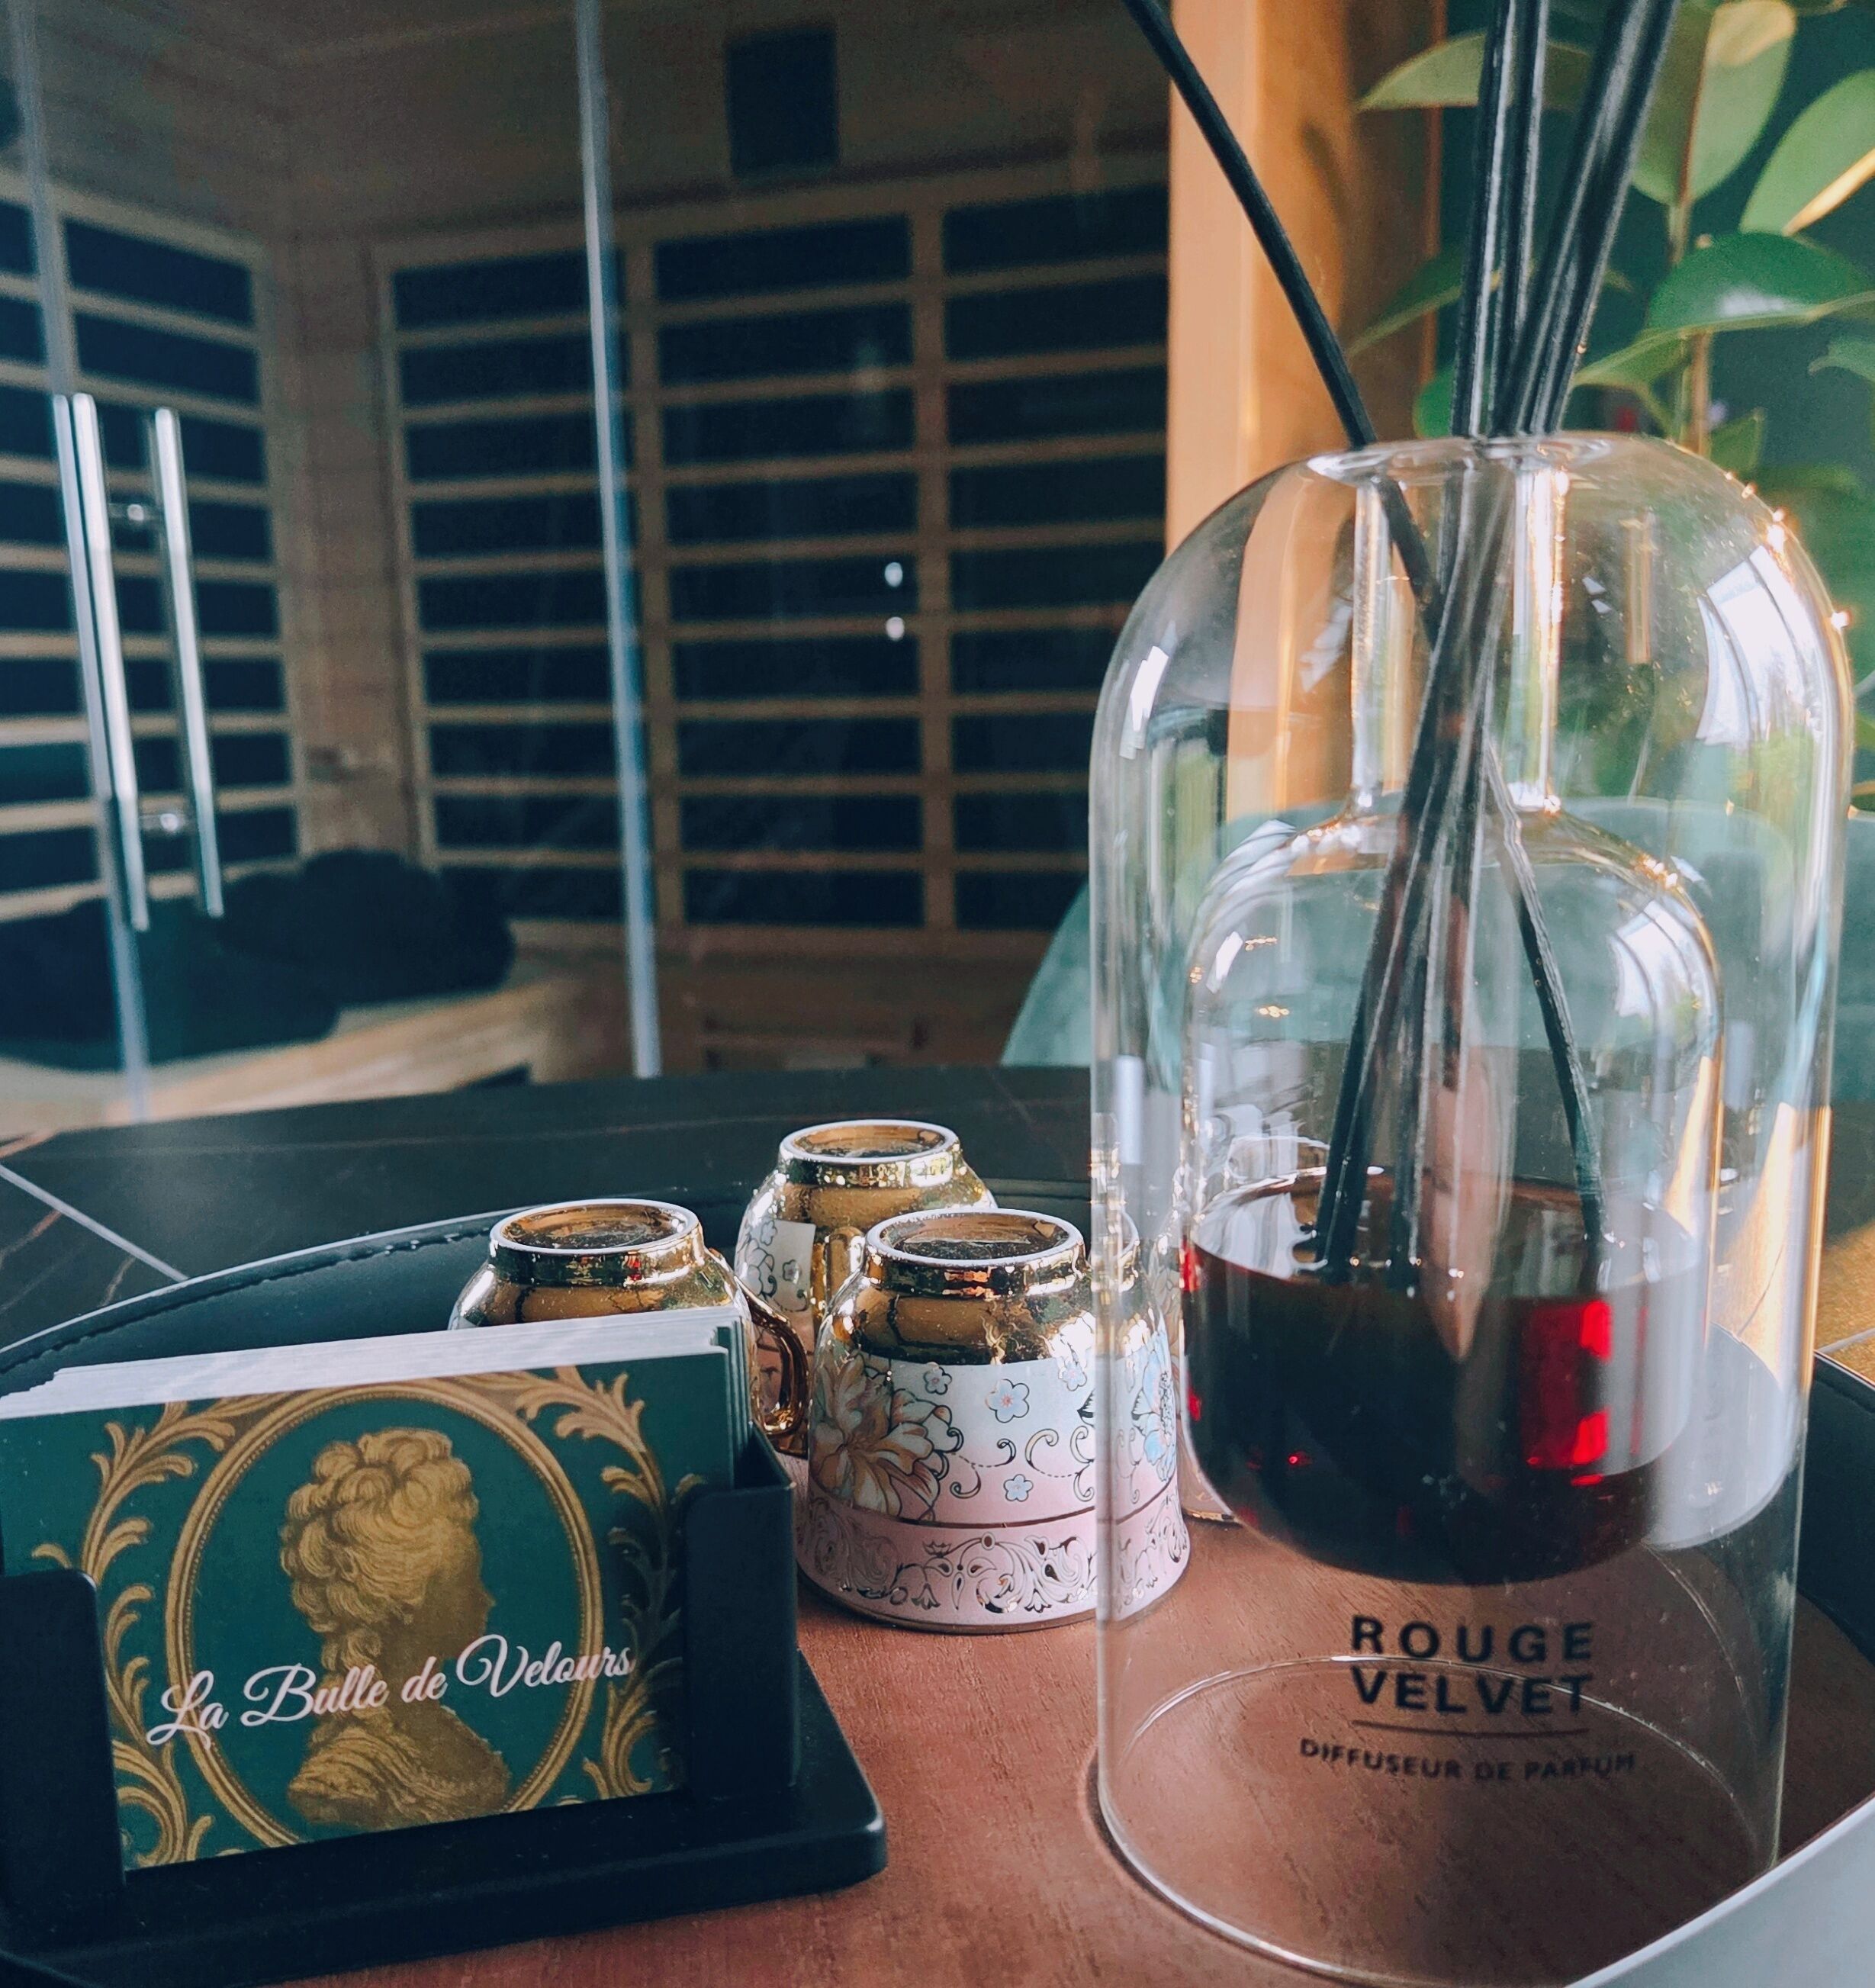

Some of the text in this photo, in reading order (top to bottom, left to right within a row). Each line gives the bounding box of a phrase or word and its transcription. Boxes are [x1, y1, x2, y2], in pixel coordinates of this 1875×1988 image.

[1351, 1615, 1594, 1662] ROUGE
[146, 1633, 635, 1750] La Bulle de Velours
[1351, 1665, 1594, 1715] VELVET
[1299, 1738, 1636, 1781] DIFFUSEUR DE PARFUM
